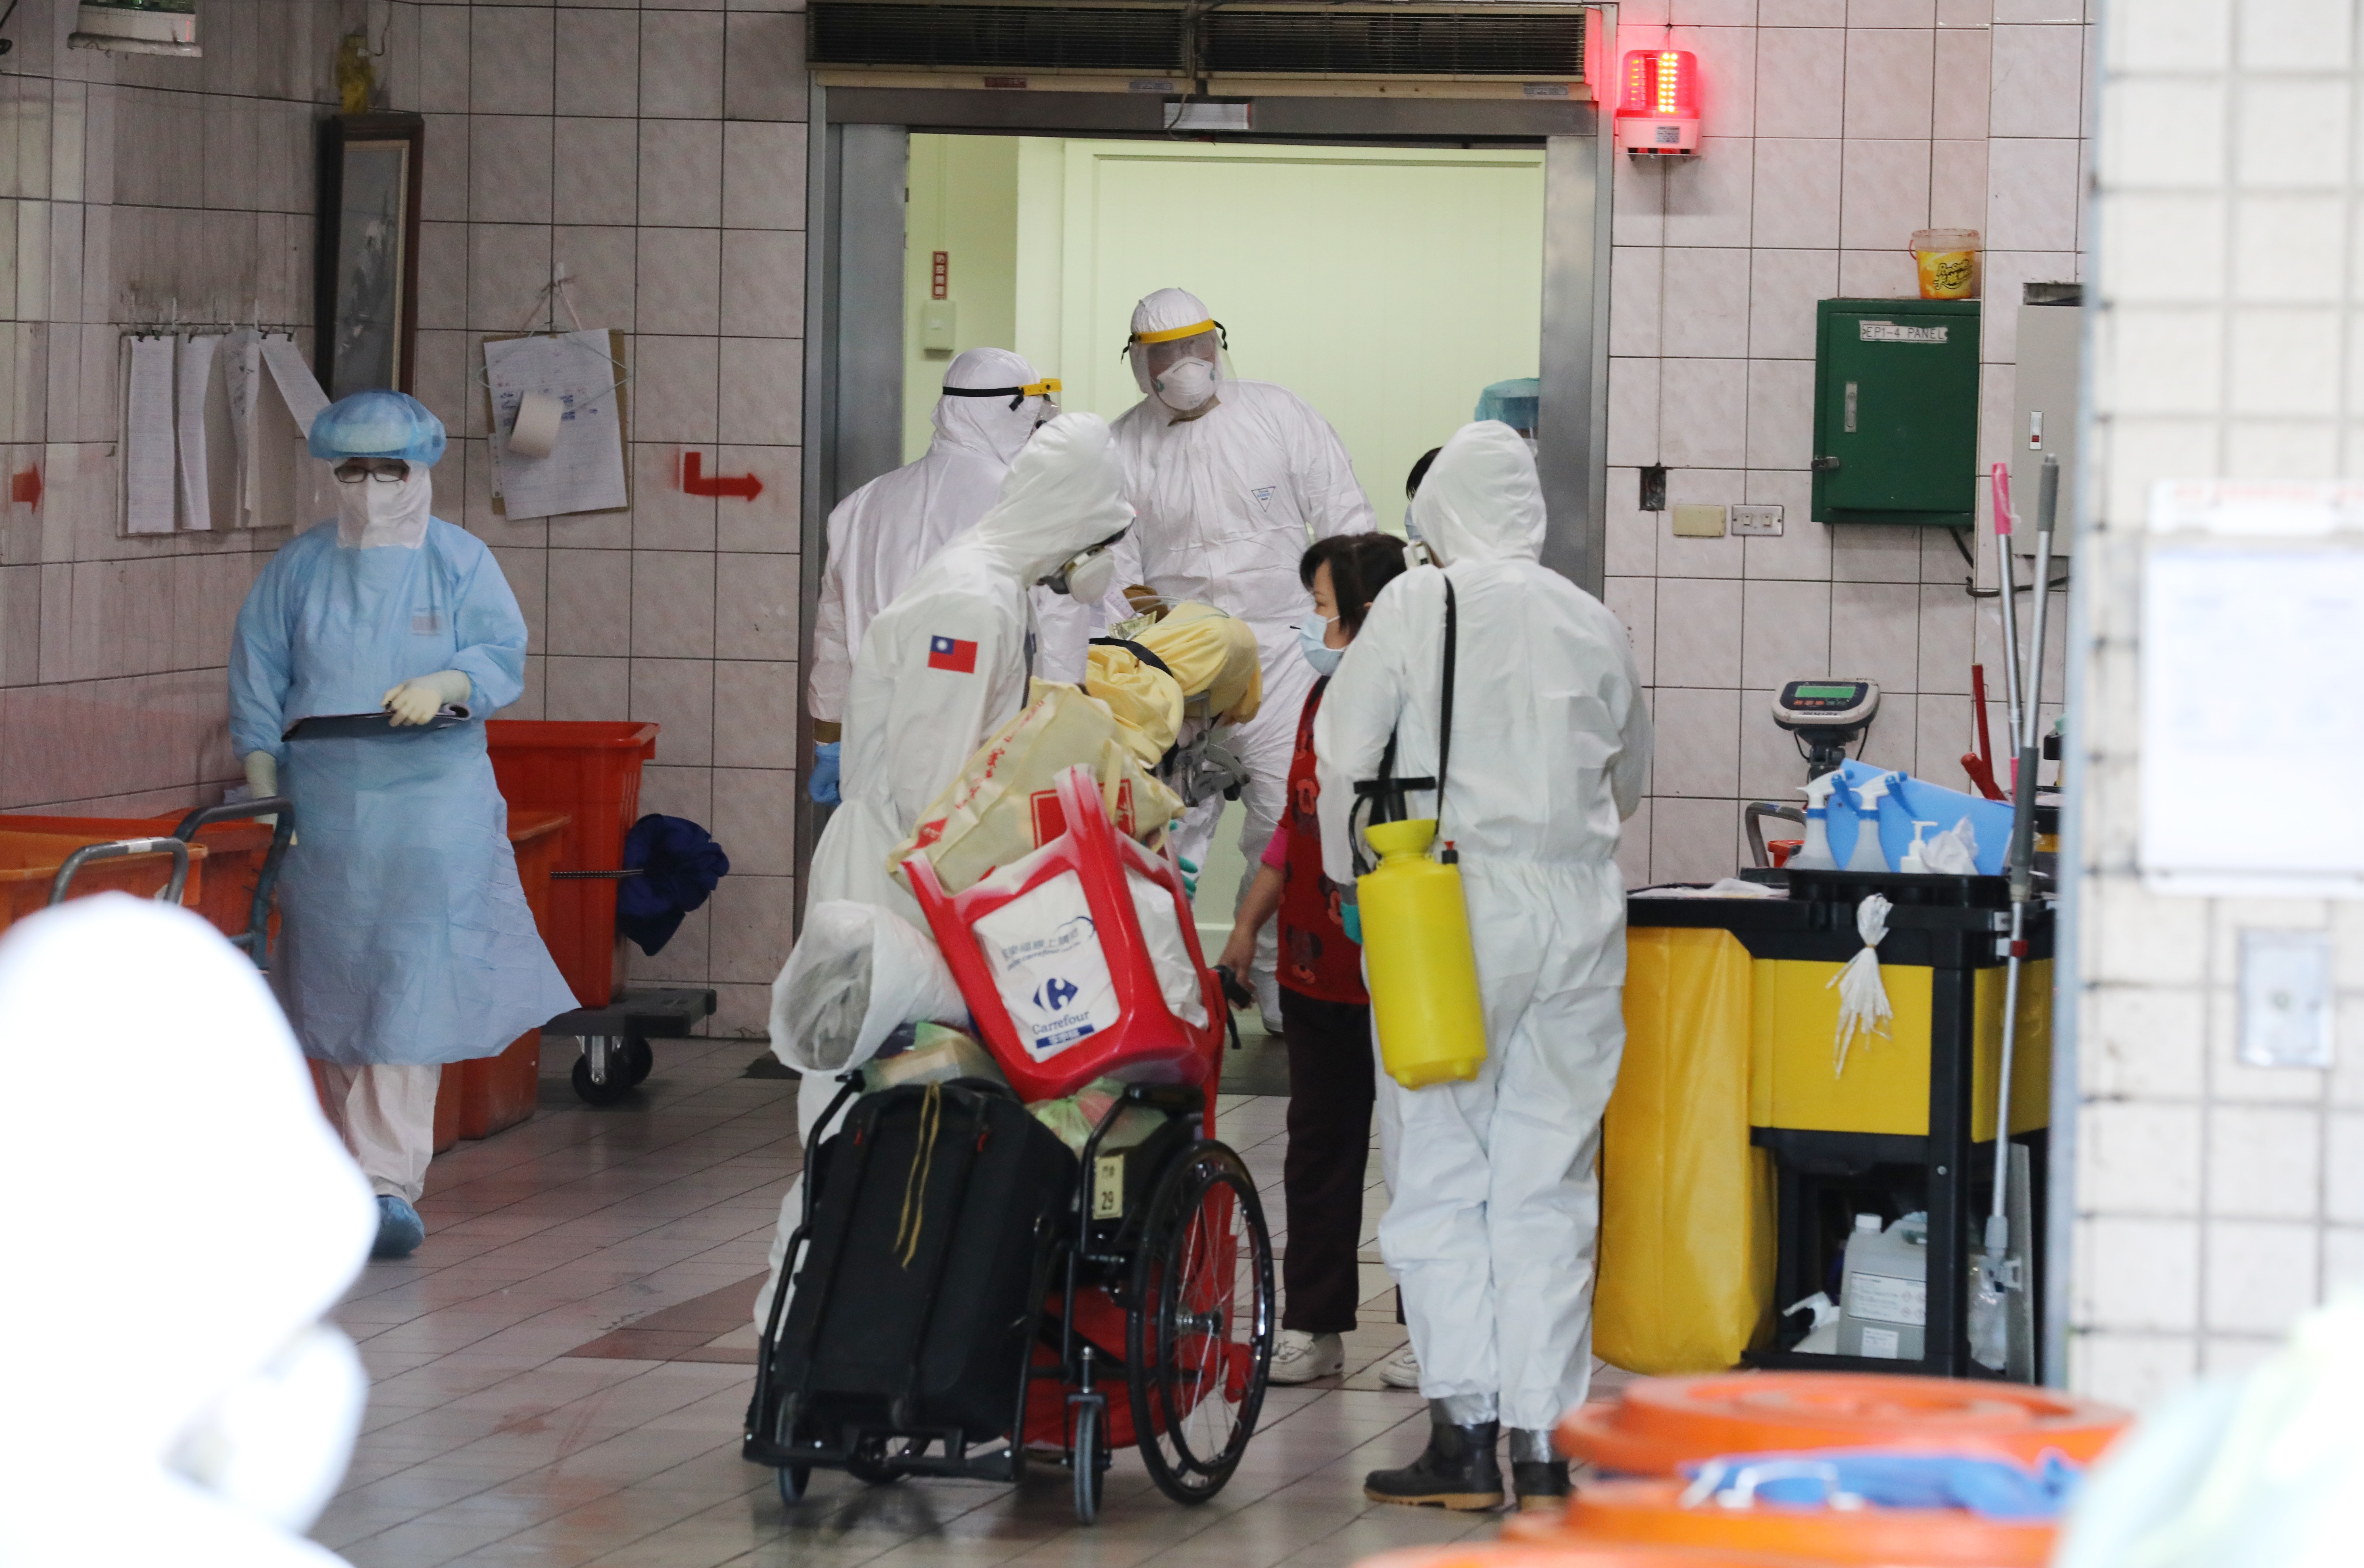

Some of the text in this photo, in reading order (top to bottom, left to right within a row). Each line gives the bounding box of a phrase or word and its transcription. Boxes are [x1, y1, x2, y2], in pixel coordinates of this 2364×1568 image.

[1907, 327, 1943, 339] PANEL
[1032, 1011, 1089, 1035] Carrefour
[1102, 1191, 1114, 1210] 29
